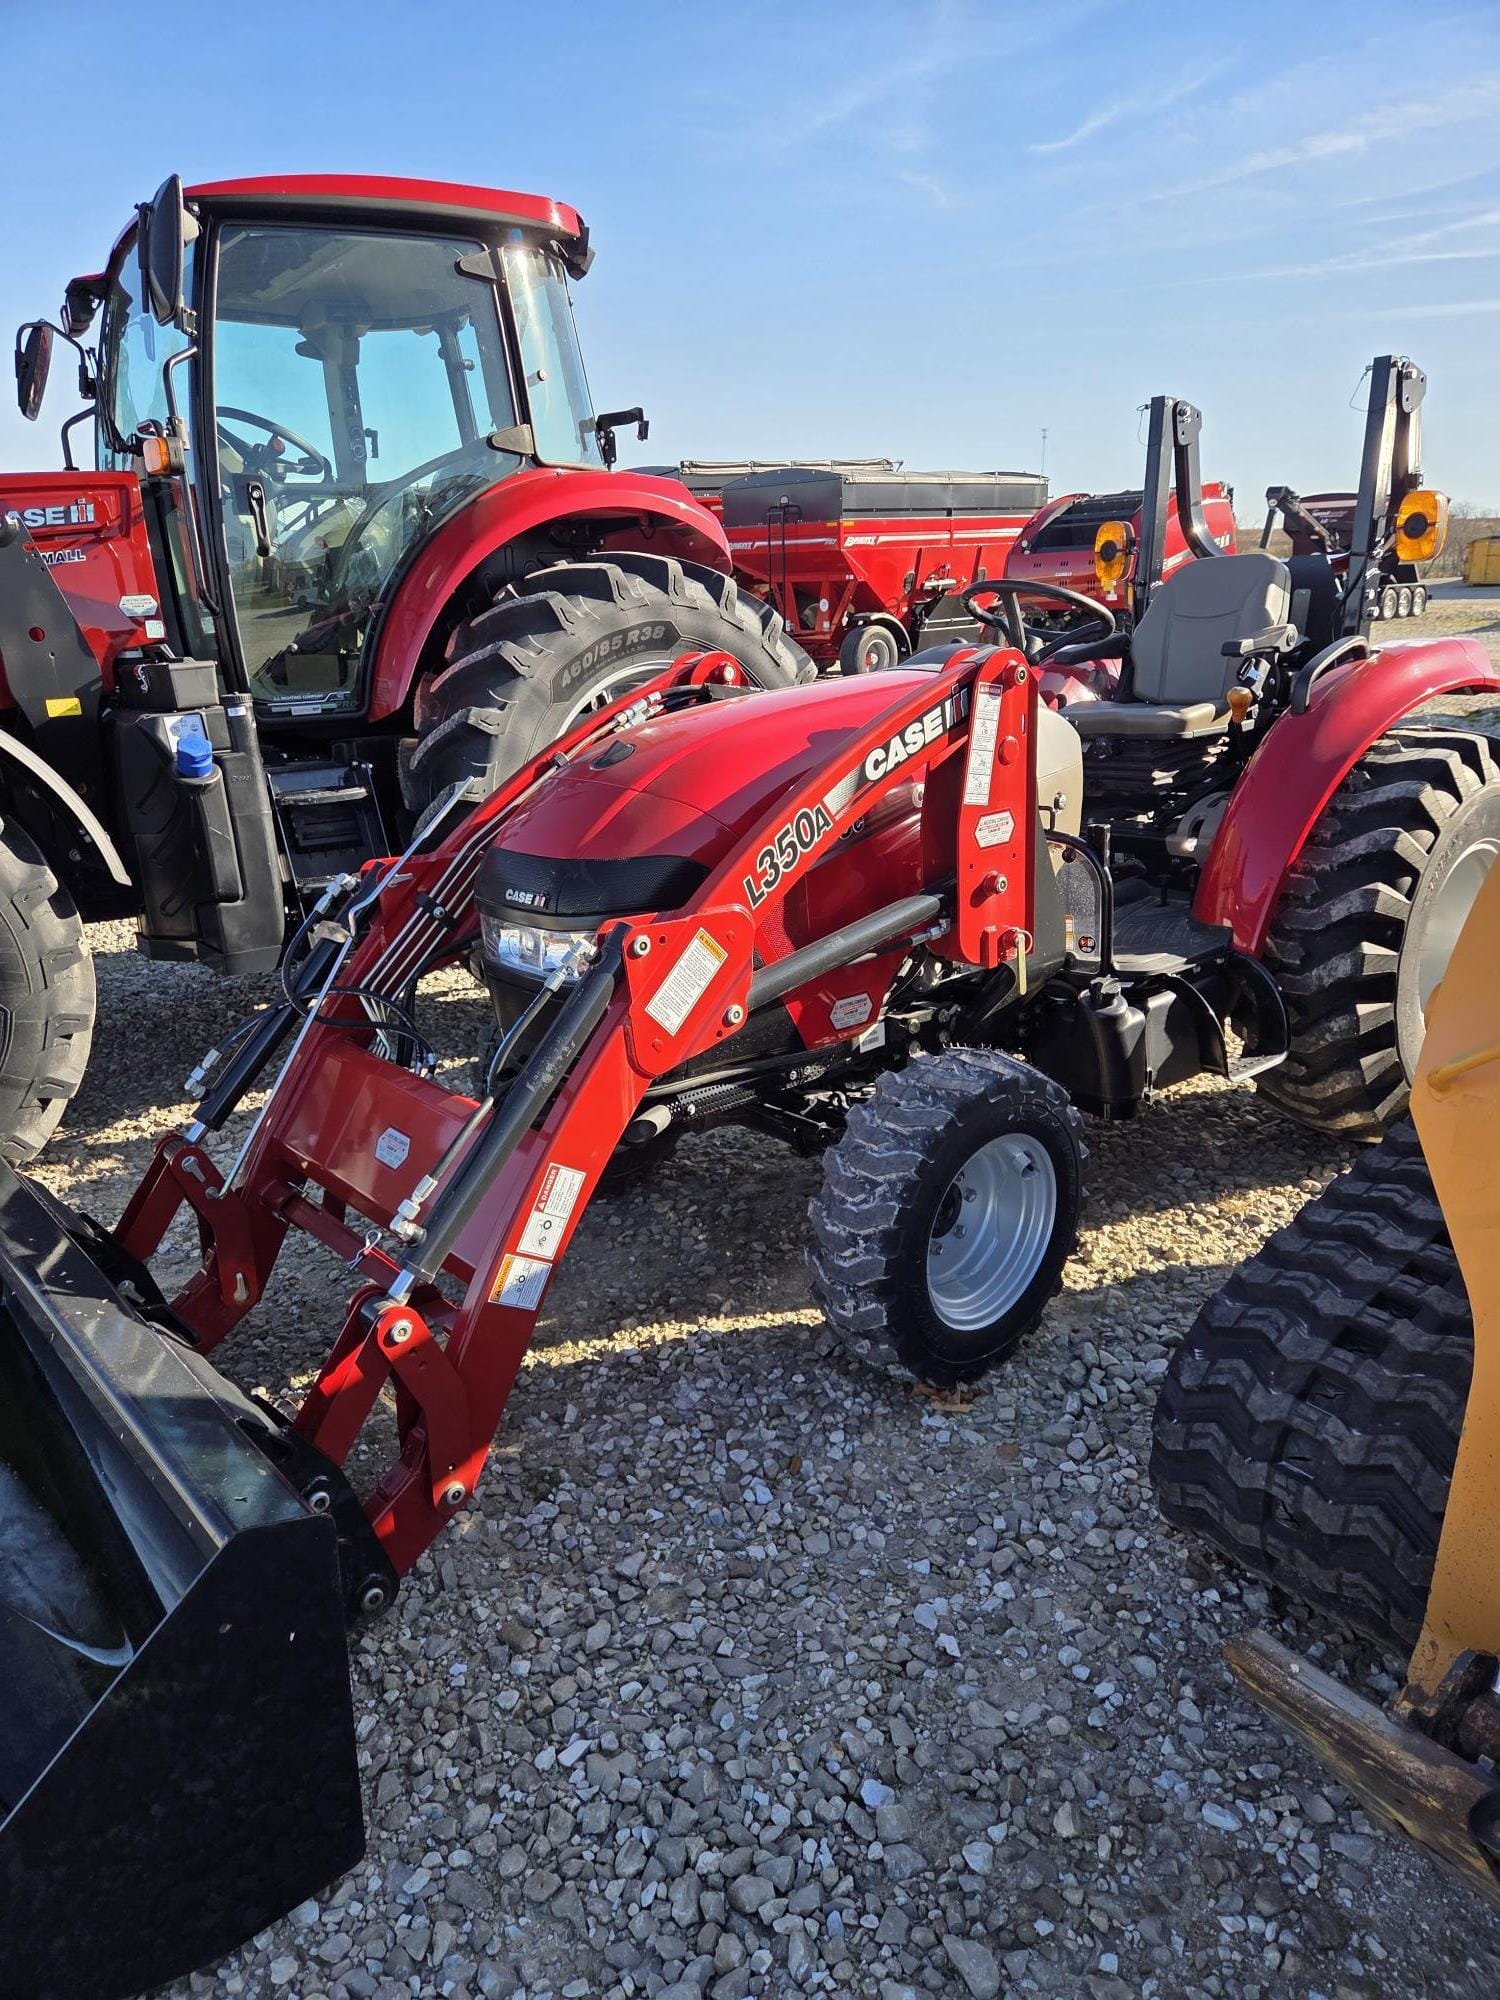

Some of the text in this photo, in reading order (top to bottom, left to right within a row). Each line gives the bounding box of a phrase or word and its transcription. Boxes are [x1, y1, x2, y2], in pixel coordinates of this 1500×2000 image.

[42, 549, 86, 564] MALL
[562, 634, 624, 689] 460/85
[626, 625, 666, 646] R38
[865, 706, 943, 781] CASE
[743, 804, 834, 910] L350A
[505, 889, 534, 905] CASE
[541, 1168, 558, 1202] DANGER
